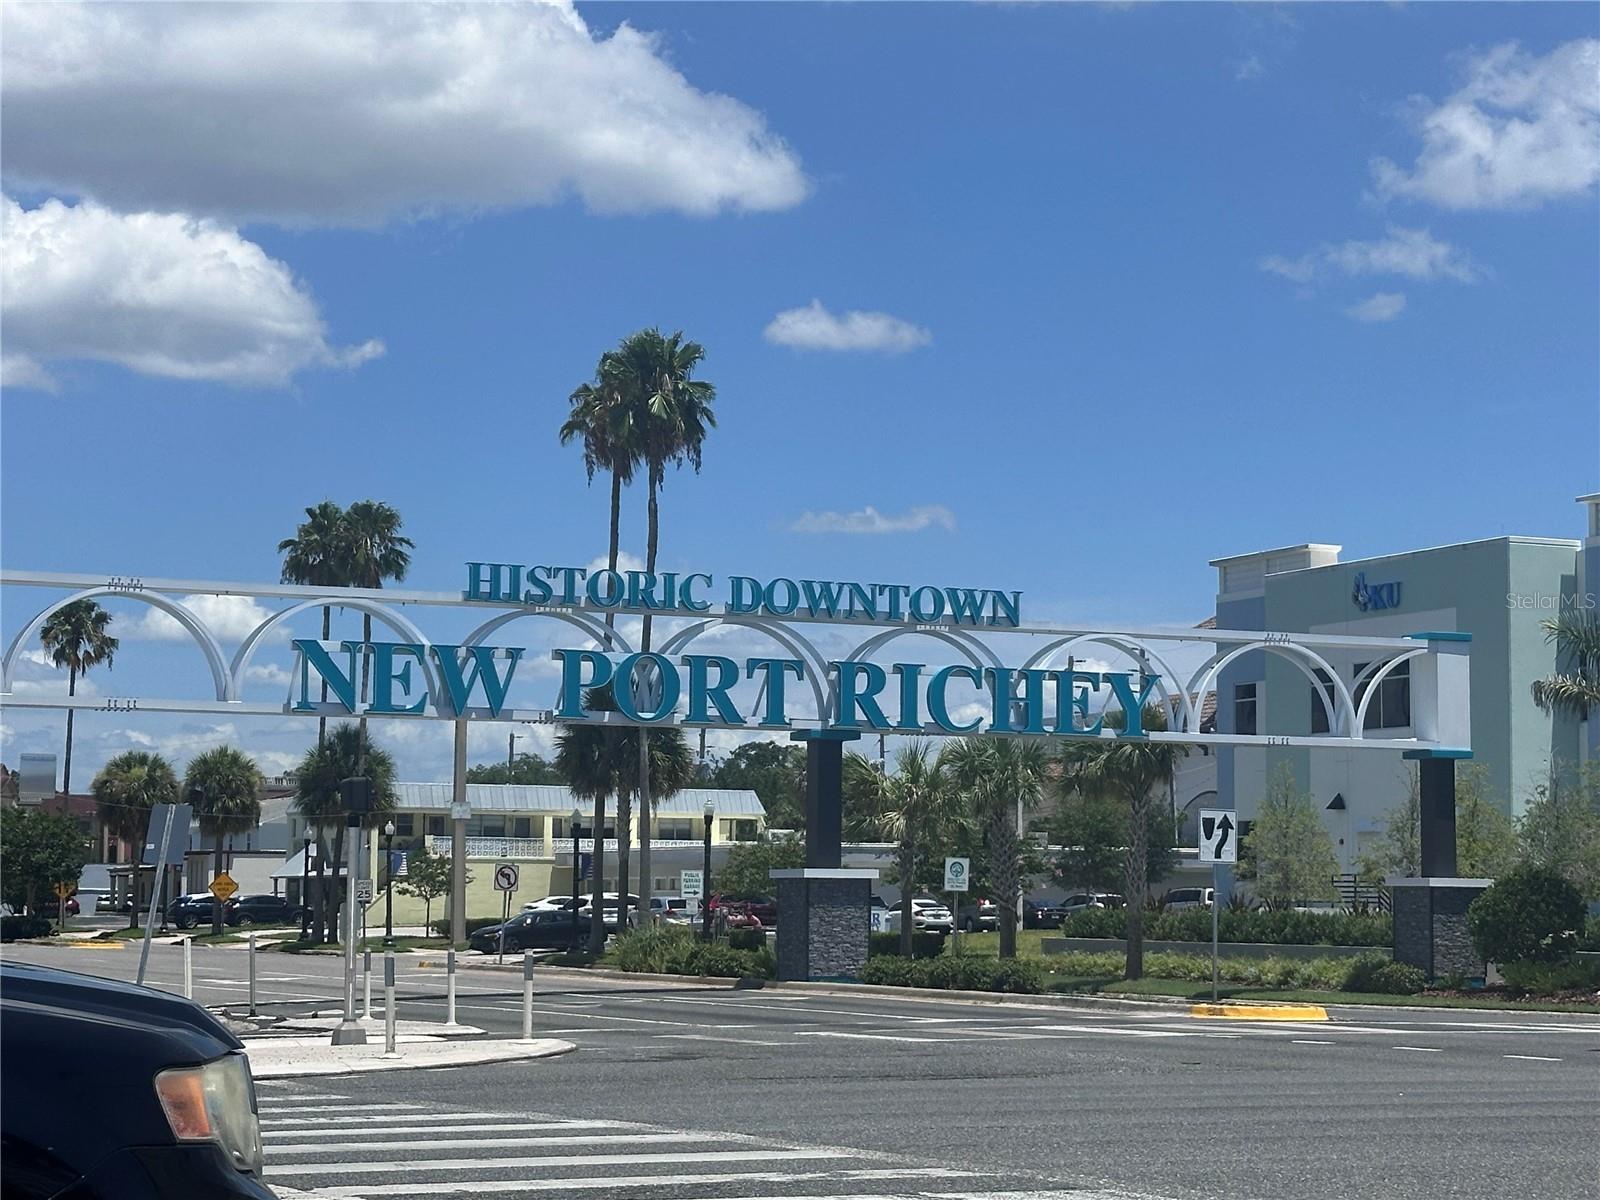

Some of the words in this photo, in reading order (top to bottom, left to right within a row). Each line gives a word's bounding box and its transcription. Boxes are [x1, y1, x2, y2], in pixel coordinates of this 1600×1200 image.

[464, 562, 713, 611] HISTORIC
[727, 576, 1024, 628] DOWNTOWN
[292, 639, 526, 718] NEW
[552, 649, 804, 726] PORT
[829, 661, 1163, 737] RICHEY
[357, 890, 371, 898] 25
